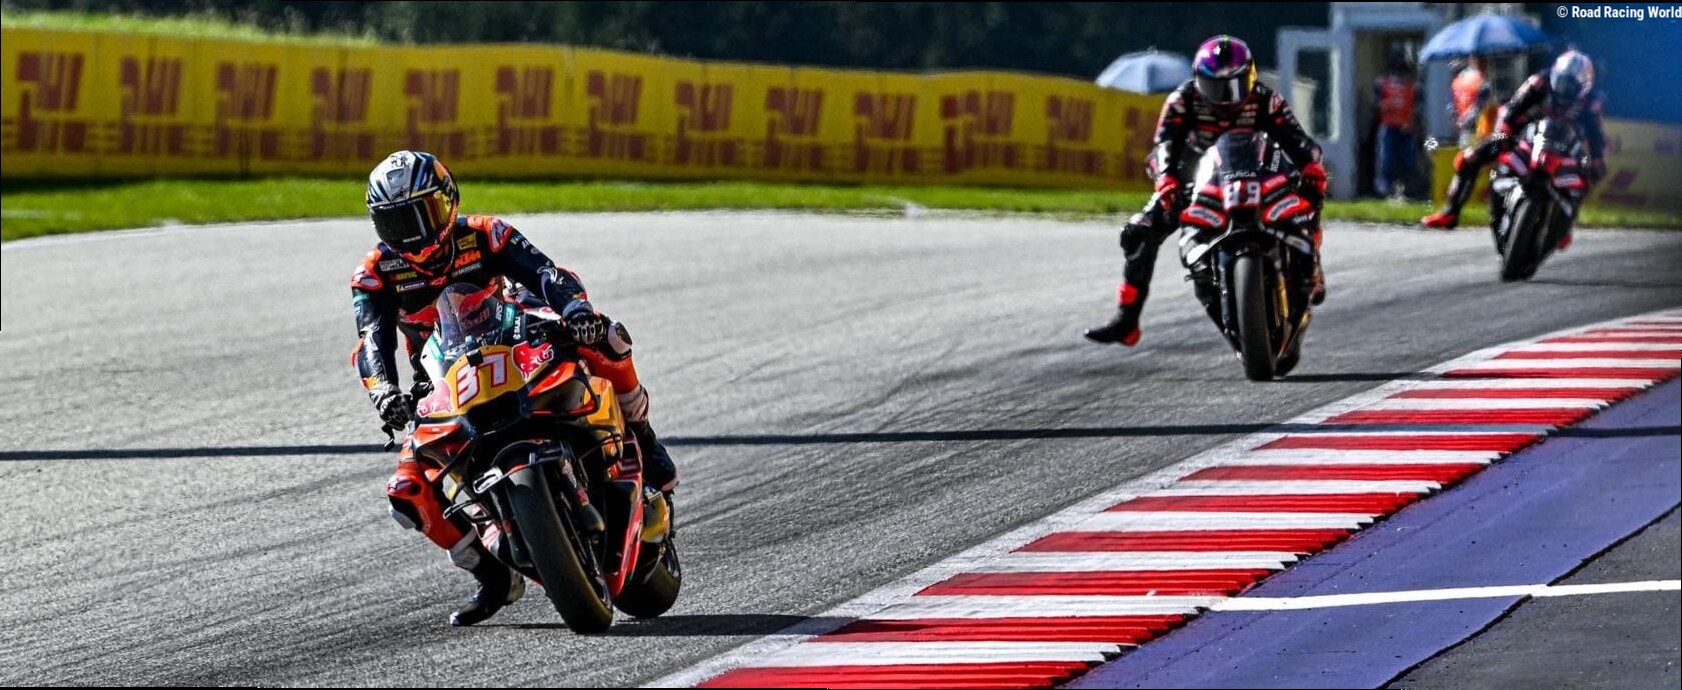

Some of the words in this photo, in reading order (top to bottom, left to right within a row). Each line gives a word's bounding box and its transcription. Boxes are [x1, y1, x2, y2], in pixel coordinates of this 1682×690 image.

[1223, 180, 1262, 211] 89
[454, 250, 482, 269] KTM
[456, 351, 510, 409] 37
